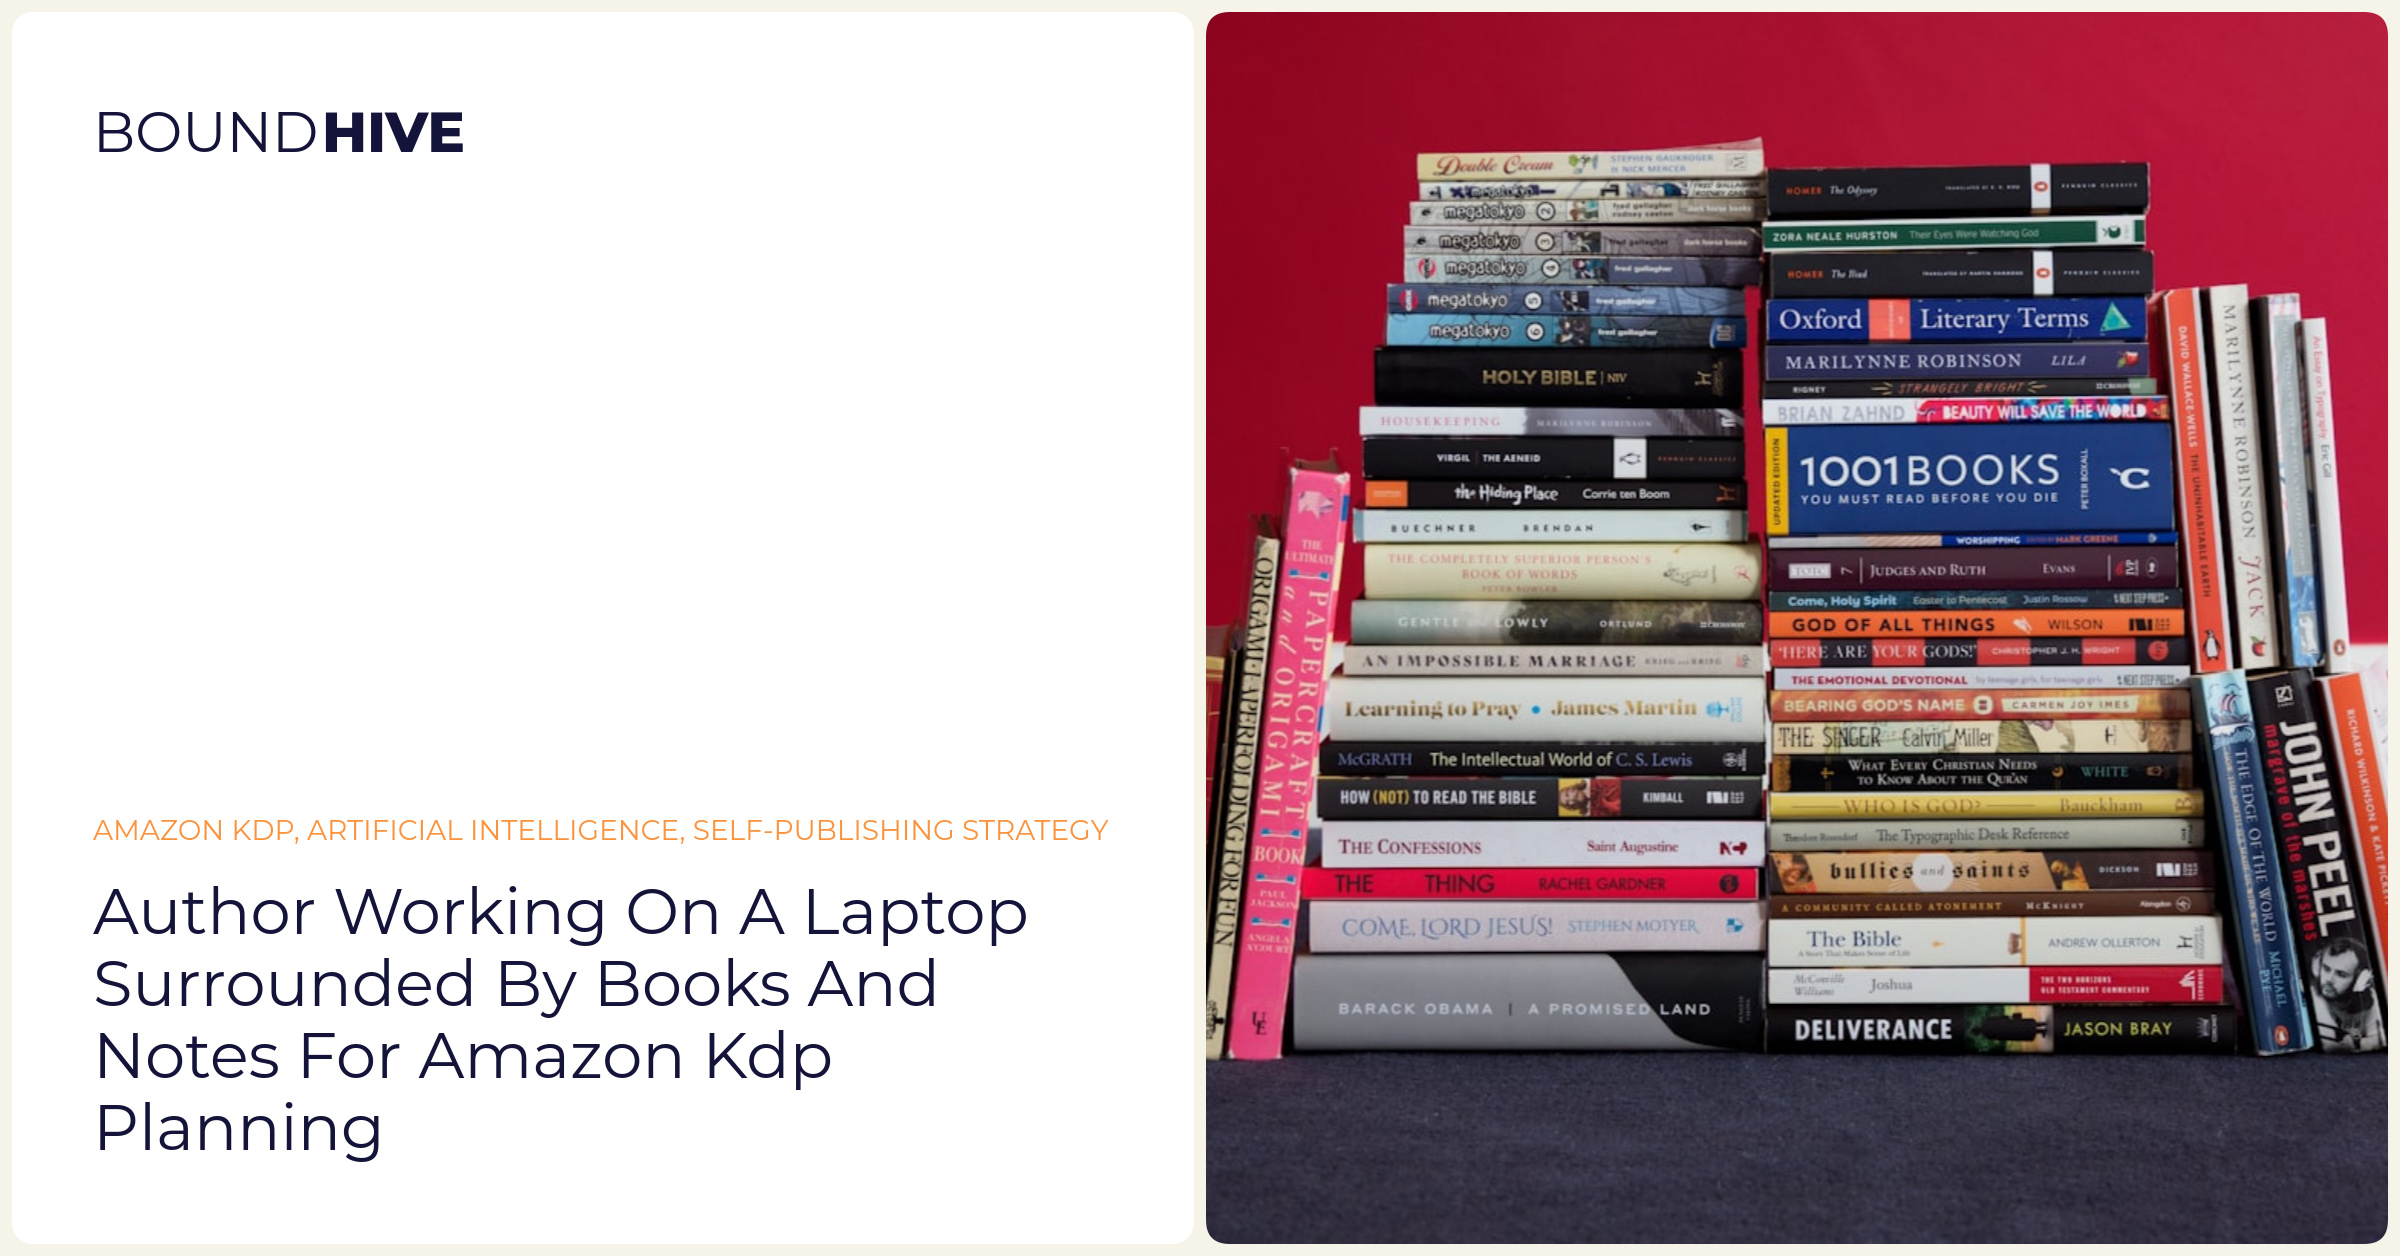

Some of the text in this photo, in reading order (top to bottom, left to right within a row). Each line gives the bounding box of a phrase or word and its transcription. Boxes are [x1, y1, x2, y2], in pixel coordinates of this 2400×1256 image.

[1432, 155, 1553, 175] Double Cream
[1786, 186, 1823, 195] HOMER
[1444, 202, 1525, 221] megatokyo
[1772, 230, 1898, 242] ZORA NEALE HURSTON
[1910, 228, 2040, 241] Their Eyes Were Watching God
[1633, 264, 1672, 274] gallagher
[1787, 270, 1823, 279] HOMER
[1428, 292, 1509, 309] megatokyo
[1779, 308, 1862, 330] Oxford
[1920, 308, 2011, 333] Literary
[2017, 307, 2089, 329] Terms
[1786, 354, 2022, 370] MARILYNNE ROBINSON
[1482, 370, 1628, 385] HOLY BIBLE NIV
[2177, 325, 2199, 448] DAVID WALLACE-WELLS
[2312, 335, 2327, 440] An Essay on Typography
[1943, 404, 2147, 420] BEAUTY WILL SAVE THE WORLD
[1381, 416, 1501, 427] HOUSEKEEPING
[2223, 305, 2255, 540] MARILYNNE ROBINSON
[1437, 454, 1541, 463] VIRGIL THE AENEID
[1773, 438, 1782, 526] UPDATED EDITION
[1582, 488, 1670, 499] Corrie ten Boom
[1802, 492, 2058, 505] YOU MUST READ BEFORE YOU DIE
[1391, 524, 1476, 533] BUECHNER
[1523, 524, 1593, 533] BRENDAN
[2056, 535, 2081, 543] MARK
[2084, 535, 2119, 543] GREENE
[1285, 540, 1336, 566] THE ULTIMATE
[1462, 569, 1578, 579] BOOK OF WORDS
[2237, 555, 2265, 618] JACK
[1788, 595, 1897, 608] Come, Holy Spirit
[1792, 618, 1996, 632] GOD OF ALL THINGS
[2048, 619, 2103, 631] WILSON
[1792, 675, 1968, 685] THE EMOTIONAL DEVOTIONAL
[1285, 590, 1330, 821] PAPERCRAFT
[1344, 701, 1521, 720] Learning to Pray
[2012, 700, 2130, 709] CARMEN JOY IMES
[1338, 752, 1413, 767] McGRATH
[2234, 750, 2251, 781] THE
[2081, 766, 2130, 778] WHITE
[1340, 790, 1536, 805] HOW (NOT) TO READ THE BIBLE
[1642, 791, 1684, 803] KIMBALL
[2240, 784, 2259, 823] EDGE
[2060, 798, 2144, 813] Bauckham
[1876, 827, 2070, 844] The Typographic Desk Reference
[2279, 721, 2356, 937] JOHN PEEL
[2249, 827, 2263, 849] OF
[1586, 839, 1679, 855] Saint Augustine
[1254, 846, 1302, 865] BOOK
[2099, 865, 2140, 873] DICKSON
[2252, 851, 2268, 882] THE
[1334, 874, 1495, 893] THE THING
[1539, 876, 1666, 891] RACHEL GARDNER
[1259, 890, 1286, 899] PAUL
[2258, 886, 2277, 943] WORLD
[1248, 933, 1290, 944] ANGELA
[1806, 929, 1902, 948] The Bible
[2048, 936, 2161, 949] ANDREW OLLERTON
[1869, 977, 1913, 993] Joshua
[2041, 975, 2113, 984] THE TWO HORIZONS
[2259, 950, 2286, 1008] MICHAEL PYE
[2041, 985, 2150, 995] OLD TESTAMENT COMMENTARY
[1339, 1003, 1493, 1016] BARACK OBAMA
[1528, 1003, 1712, 1016] A PROMISED LAND
[1794, 1018, 1953, 1041] DELIVERANCE
[2064, 1021, 2173, 1037] JASON BRAY
